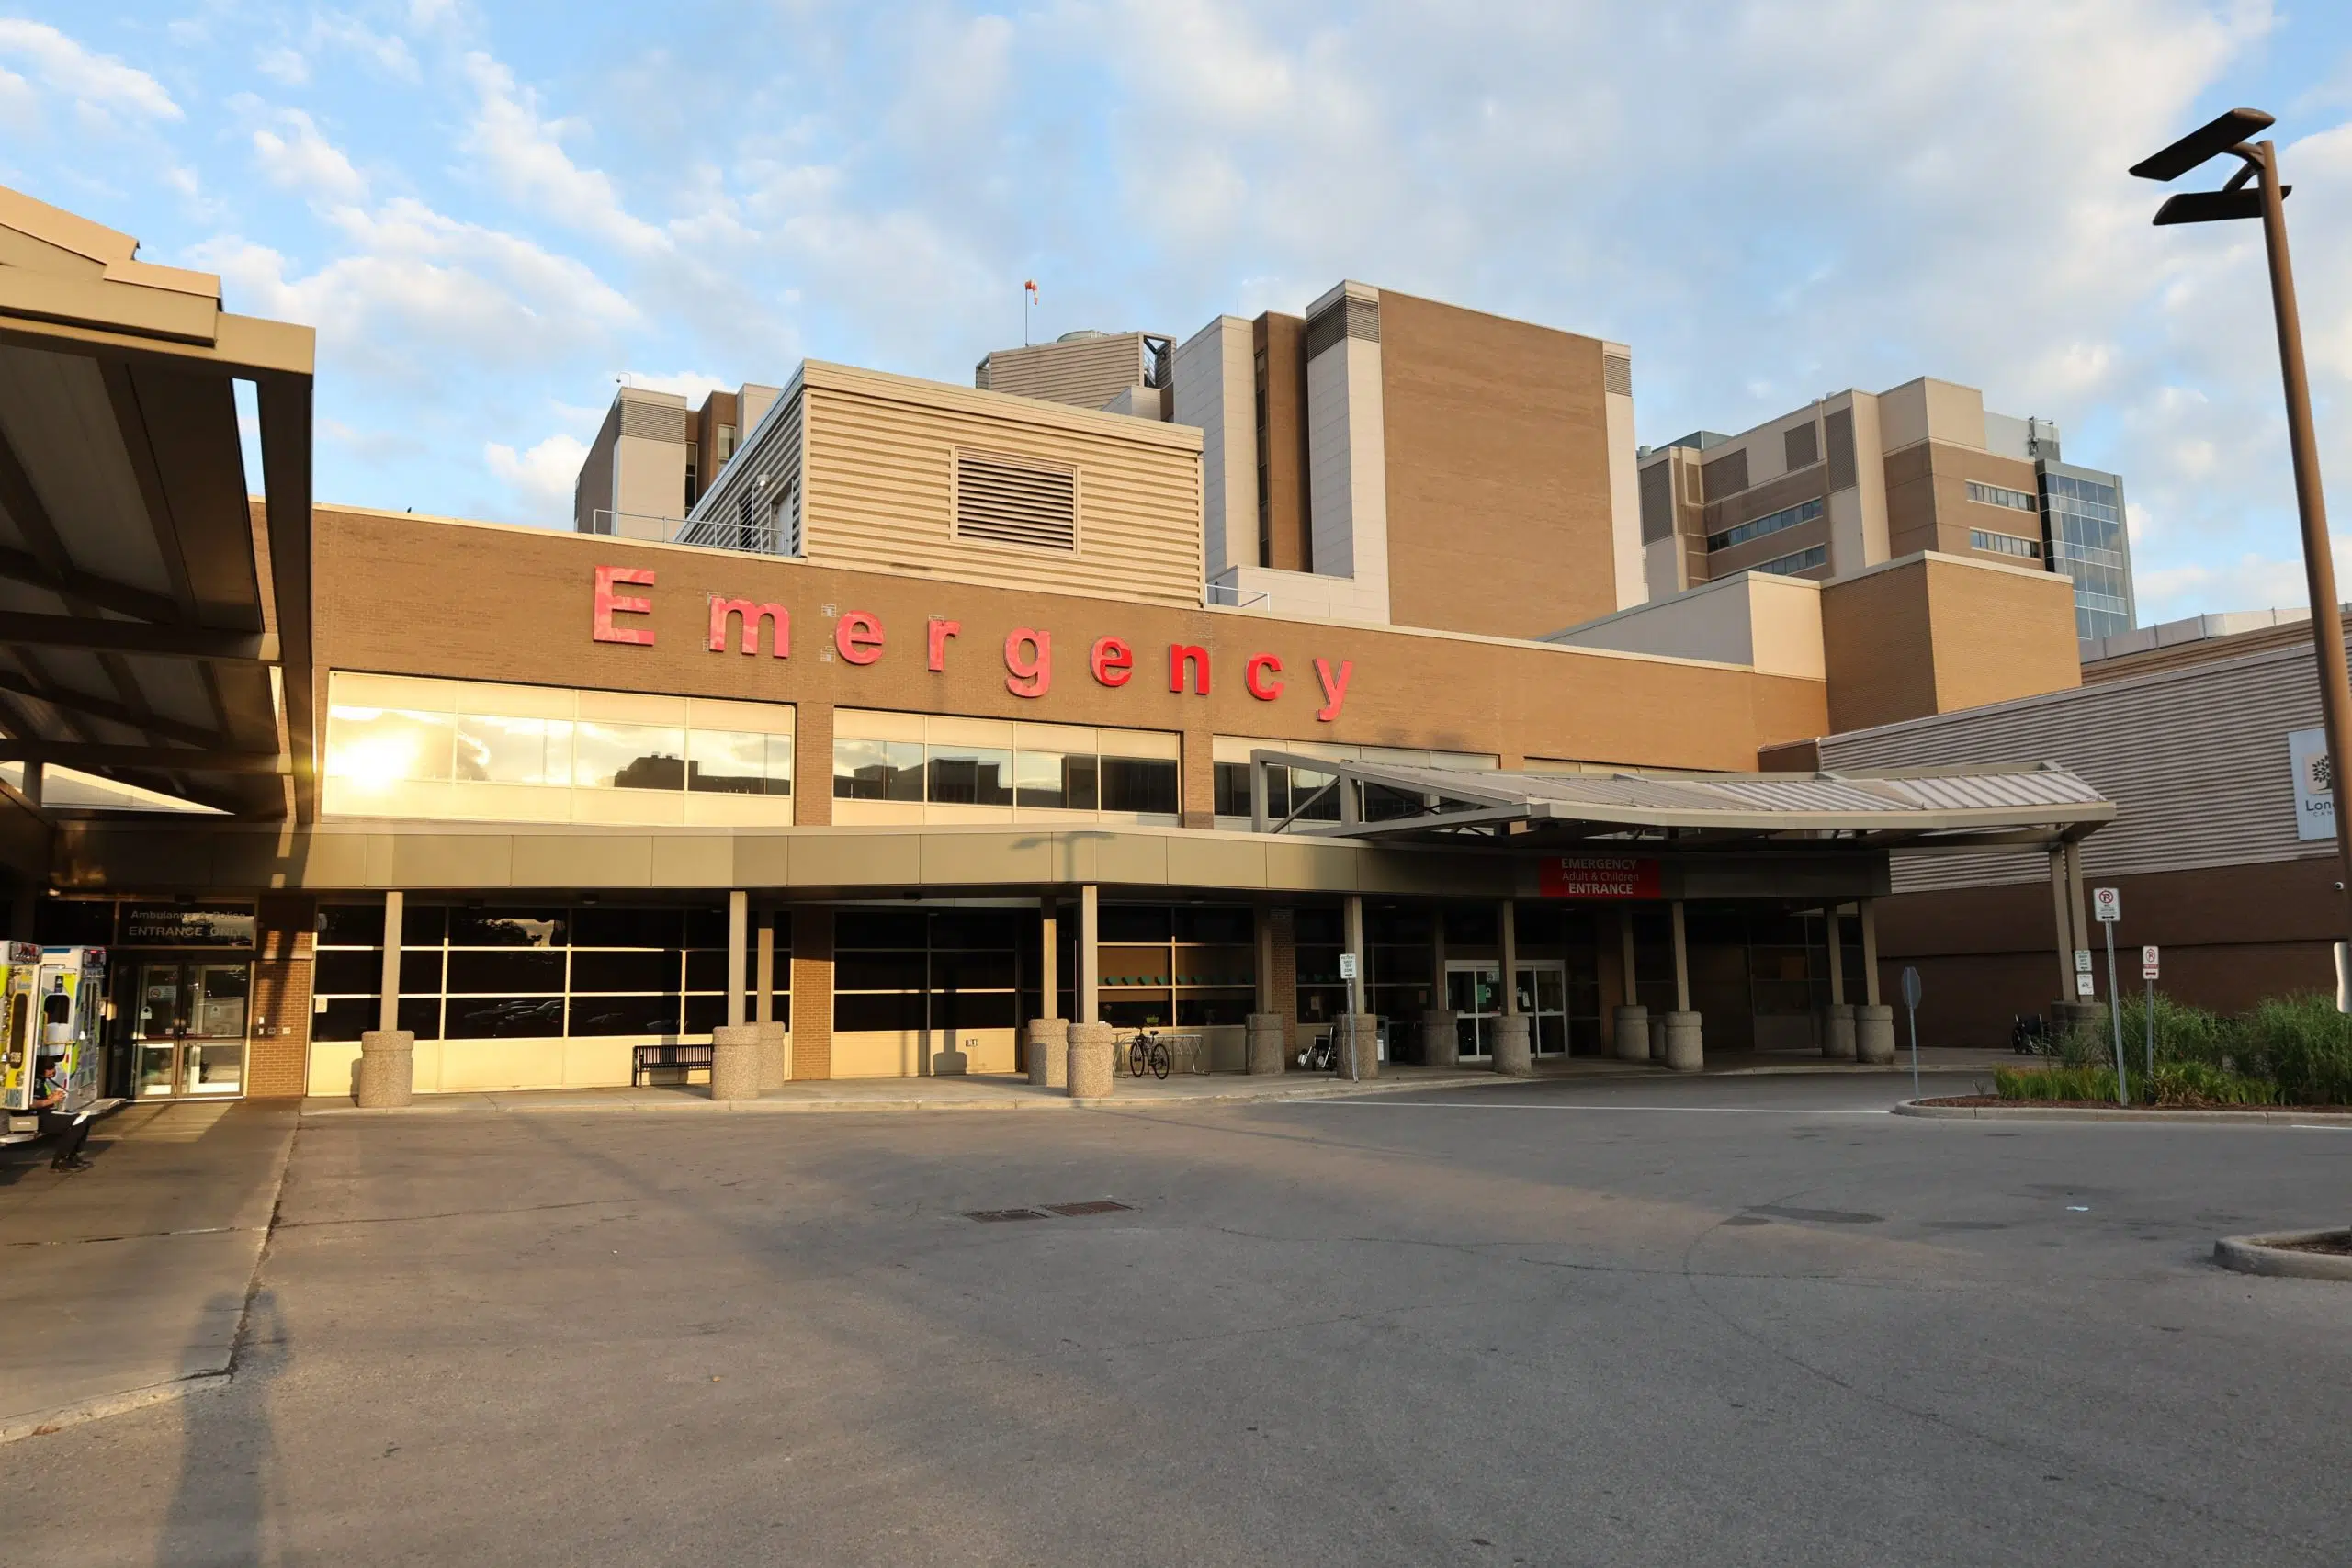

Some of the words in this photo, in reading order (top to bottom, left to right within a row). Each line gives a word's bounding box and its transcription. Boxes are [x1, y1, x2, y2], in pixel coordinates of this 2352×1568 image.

[593, 565, 1352, 721] Emergency
[2305, 799, 2335, 811] Lon
[1561, 857, 1637, 870] EMERGENCY
[1562, 871, 1589, 882] Adult
[1590, 872, 1598, 882] &
[1600, 871, 1639, 883] Children
[1568, 882, 1634, 895] ENTRANCE
[130, 909, 194, 919] Ambulance
[129, 925, 203, 936] ENTRANCE
[209, 925, 243, 937] ONLY
